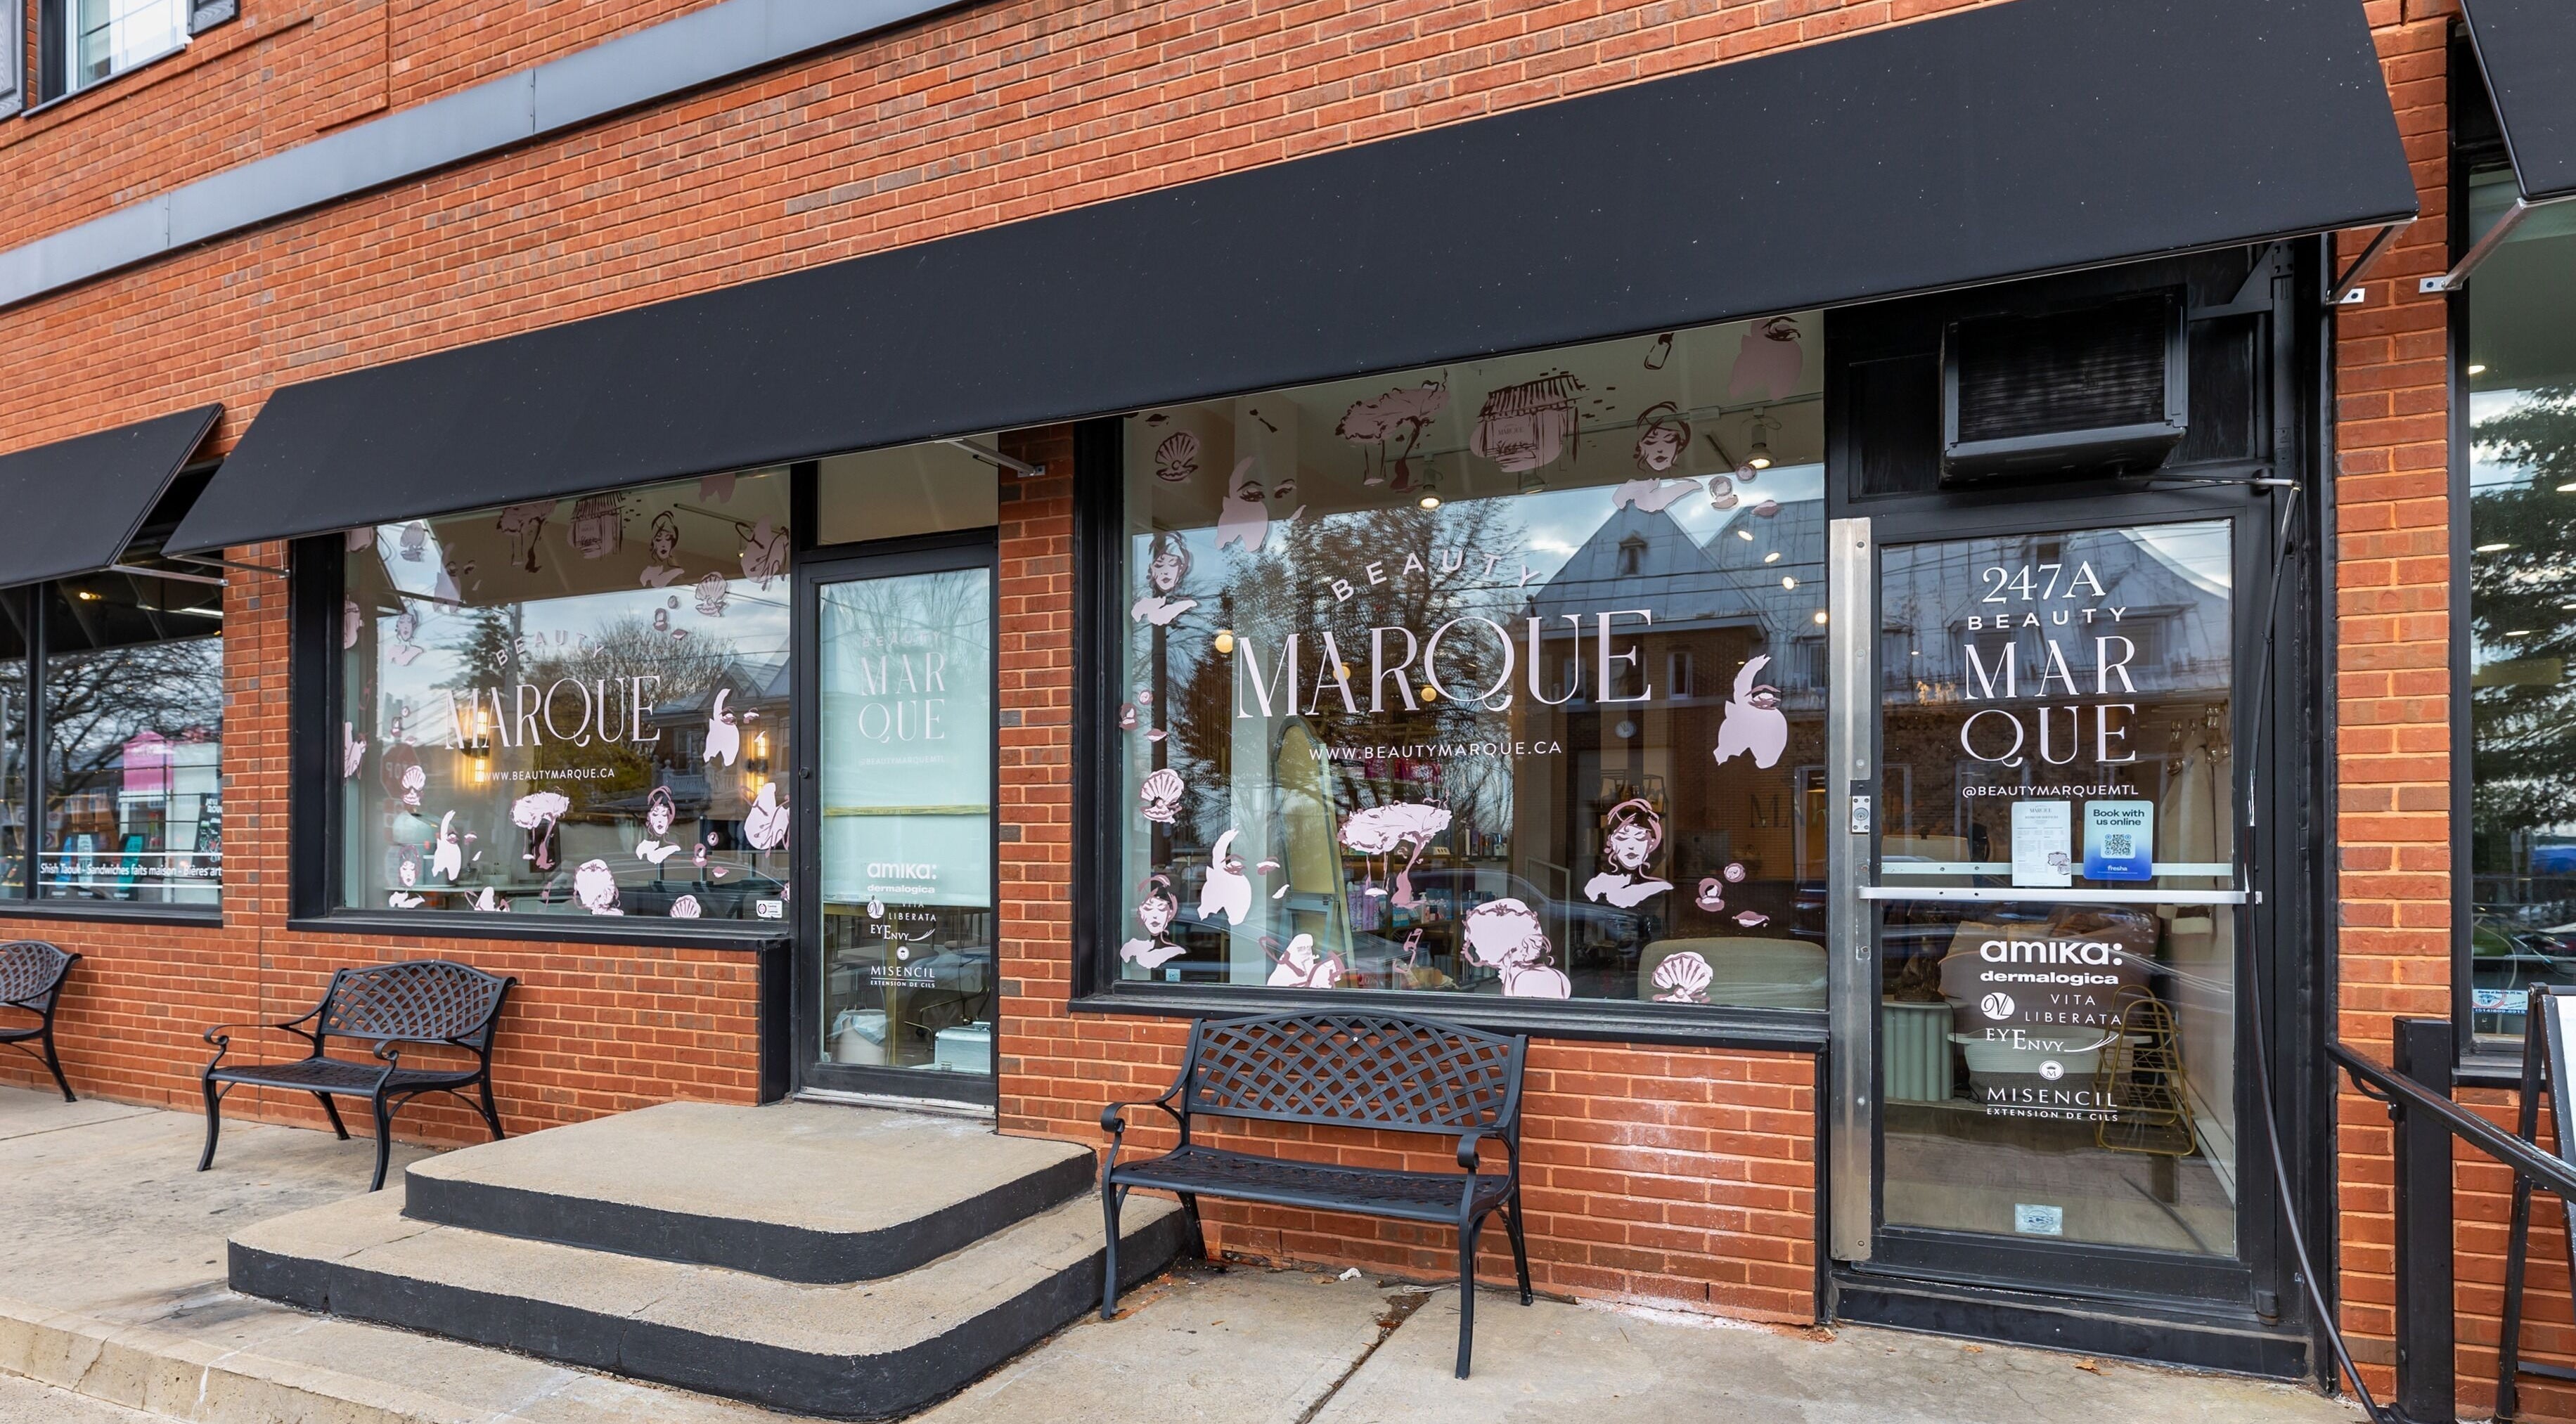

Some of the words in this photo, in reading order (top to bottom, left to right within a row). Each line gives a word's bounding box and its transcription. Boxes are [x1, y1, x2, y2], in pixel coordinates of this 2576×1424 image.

[1332, 549, 1542, 602] BEAUTY
[1983, 561, 2106, 604] 247A
[1969, 607, 2127, 630] BEAUTY
[495, 630, 605, 666] BEAUTY
[862, 631, 941, 647] BEAUTY
[1237, 609, 1651, 718] MARQUE
[1964, 635, 2138, 700] MAR
[861, 652, 946, 696] MAR
[444, 675, 661, 750] MARQUE
[859, 699, 946, 743] QUE
[1961, 704, 2137, 768] QUE
[1309, 741, 1562, 760] WWW.BEAUTYMARQUE.CA
[484, 768, 615, 781] WWW.BEAUTYMARQUE.CA
[1962, 784, 2139, 798] @BEAUTYMARQUEMTL
[40, 863, 58, 874] Shish
[60, 863, 81, 875] Taouk
[87, 864, 130, 876] Sandwiches
[131, 864, 147, 876] faits
[148, 865, 176, 876] maison
[183, 864, 208, 876] Bières
[867, 884, 935, 895] dermalogica
[889, 912, 936, 921] LIBERATA
[870, 966, 935, 978] MISENCIL
[1980, 971, 2119, 986] dermalogica
[2050, 994, 2096, 1006] VITA
[2026, 1011, 2122, 1025] LIBERATA
[1987, 1087, 2118, 1107] MISENCIL
[1987, 1108, 2059, 1118] EXTENSION
[2066, 1112, 2082, 1120] DE
[2089, 1113, 2118, 1122] CILS
